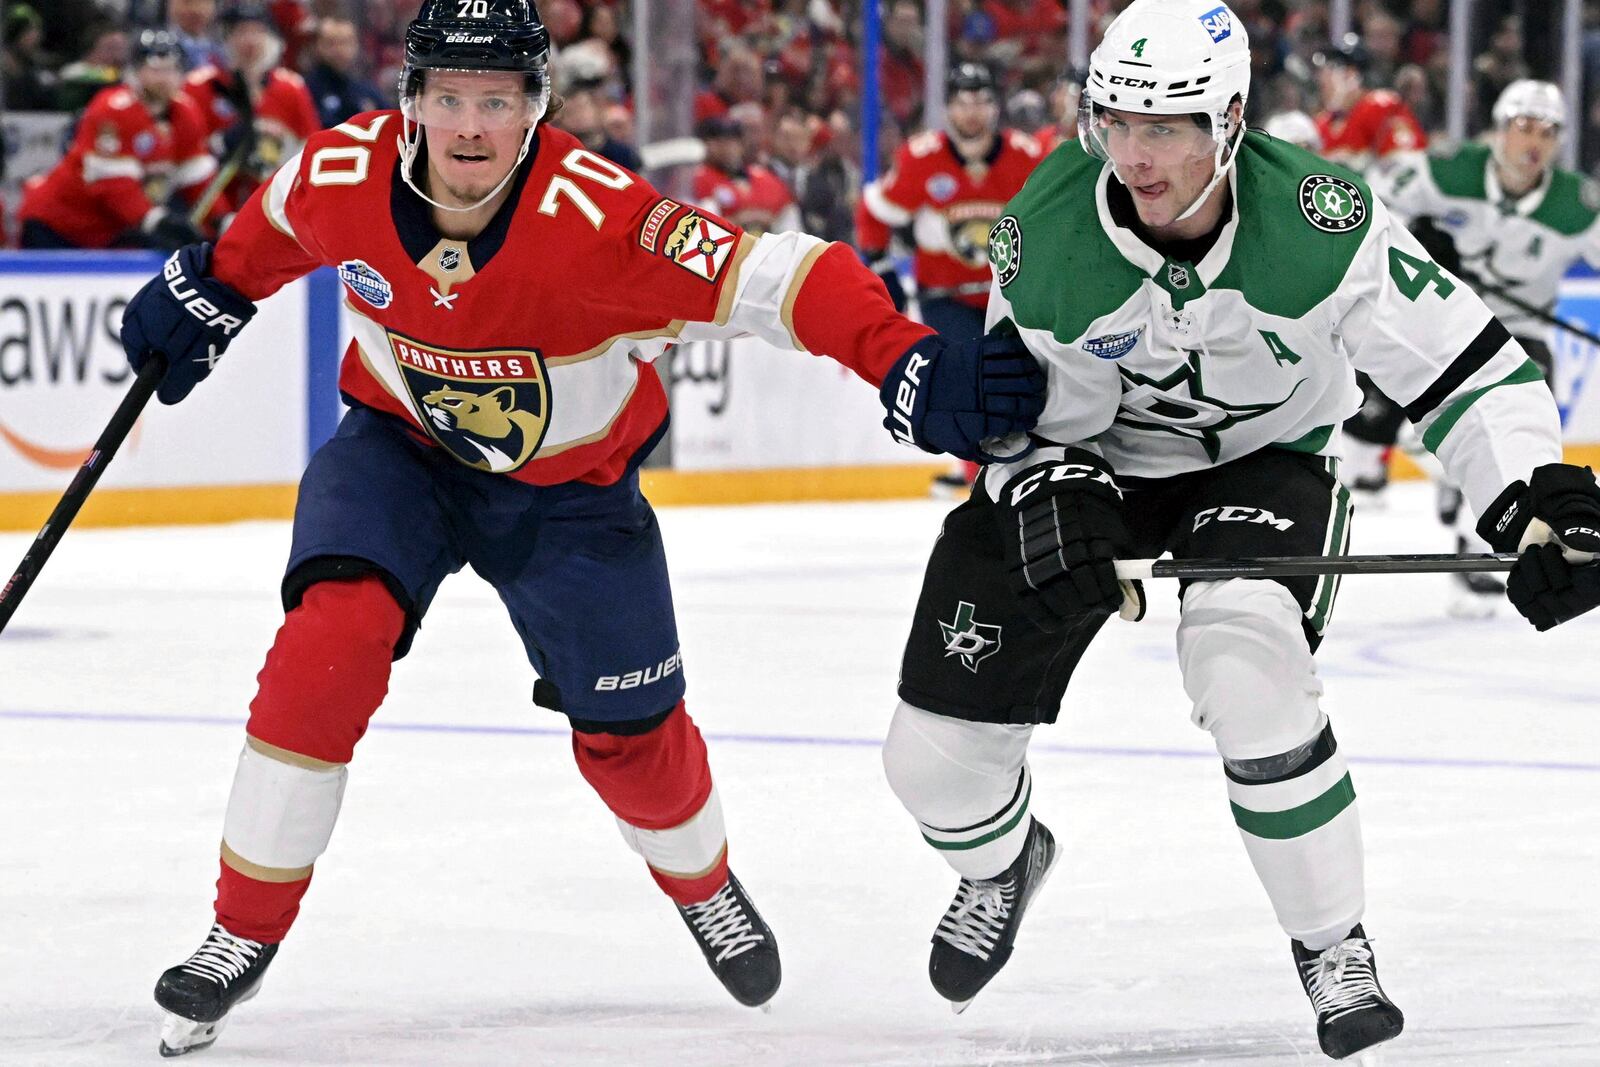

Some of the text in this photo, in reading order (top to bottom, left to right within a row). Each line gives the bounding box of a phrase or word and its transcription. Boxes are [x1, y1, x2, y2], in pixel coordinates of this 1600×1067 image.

[457, 0, 488, 18] 70
[1202, 10, 1232, 39] SAP
[1130, 37, 1148, 58] 4
[1109, 75, 1158, 90] CCM
[309, 113, 393, 188] 70
[537, 148, 635, 231] 70
[1303, 177, 1362, 228] DALLAS STARS
[644, 203, 671, 244] FLORIDA
[1000, 221, 1018, 271] DALLAS
[340, 268, 389, 296] GLOBAL
[351, 280, 383, 297] SERIES
[1388, 245, 1456, 302] 4
[0, 295, 131, 385] aws
[1082, 327, 1141, 350] GLOBAL
[1256, 328, 1302, 368] A
[399, 343, 524, 377] PANTHERS
[1192, 505, 1295, 533] CCM
[1496, 500, 1518, 532] CCM
